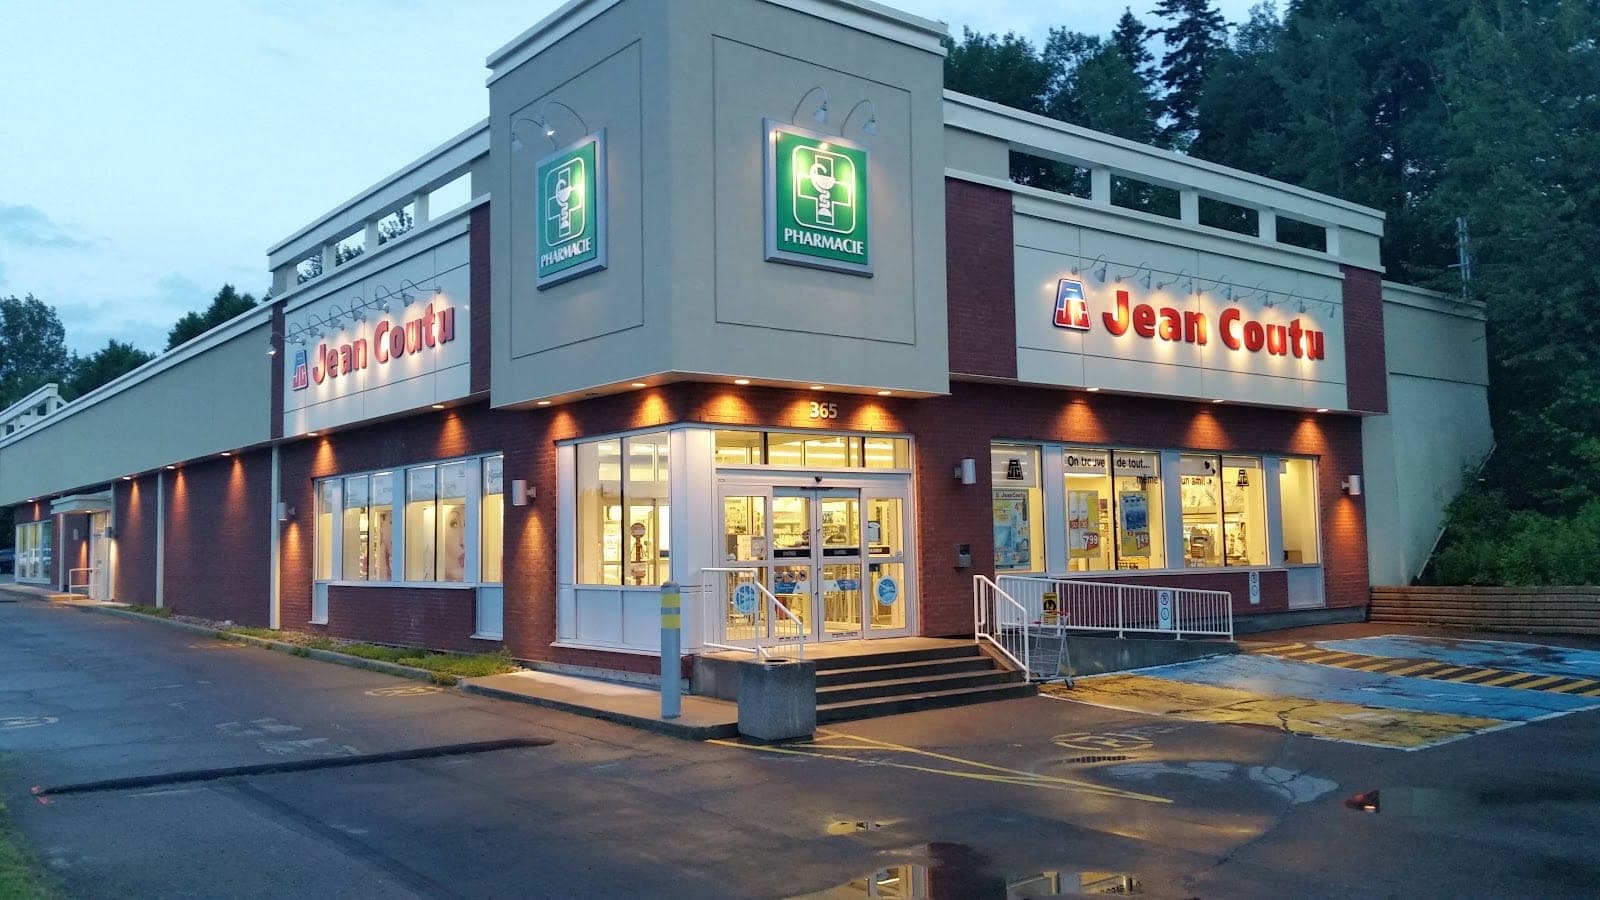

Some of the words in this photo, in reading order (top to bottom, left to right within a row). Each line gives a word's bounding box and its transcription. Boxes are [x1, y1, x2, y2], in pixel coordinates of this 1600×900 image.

[541, 237, 592, 268] PHARMACIE
[783, 227, 864, 255] PHARMACIE
[1102, 289, 1207, 346] Jean
[1219, 307, 1324, 361] Coutu
[312, 337, 367, 385] Jean
[373, 302, 454, 364] Coutu
[809, 401, 838, 419] 365
[1067, 455, 1079, 467] On
[1081, 456, 1106, 468] trouve
[1116, 457, 1127, 468] de
